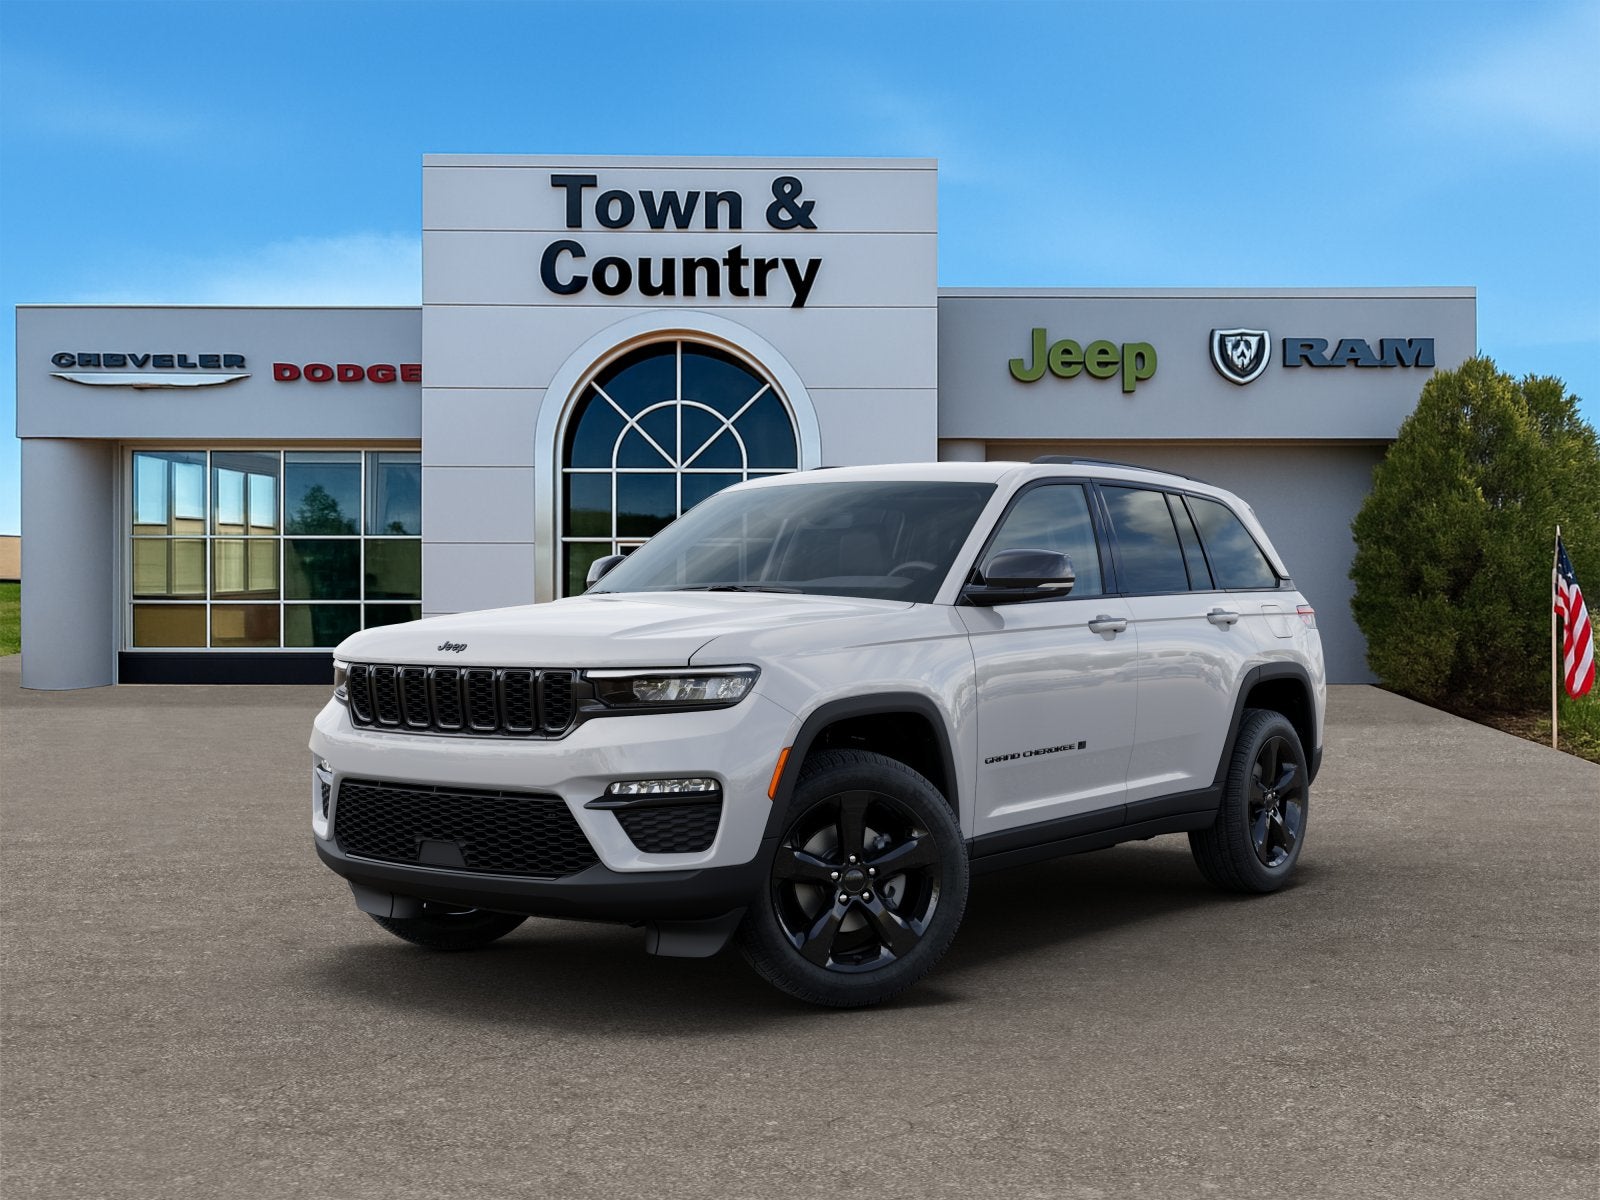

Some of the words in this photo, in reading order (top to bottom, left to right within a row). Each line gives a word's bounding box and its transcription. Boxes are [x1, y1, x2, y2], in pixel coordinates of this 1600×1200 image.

[551, 174, 742, 229] Town
[765, 176, 818, 230] &
[540, 239, 822, 308] Country
[1009, 328, 1157, 393] Jeep
[1283, 337, 1436, 368] RAM
[273, 362, 422, 383] DODGE
[437, 641, 468, 653] Jeep
[984, 753, 1021, 764] GRAND
[1023, 743, 1076, 757] CHEROKEE
